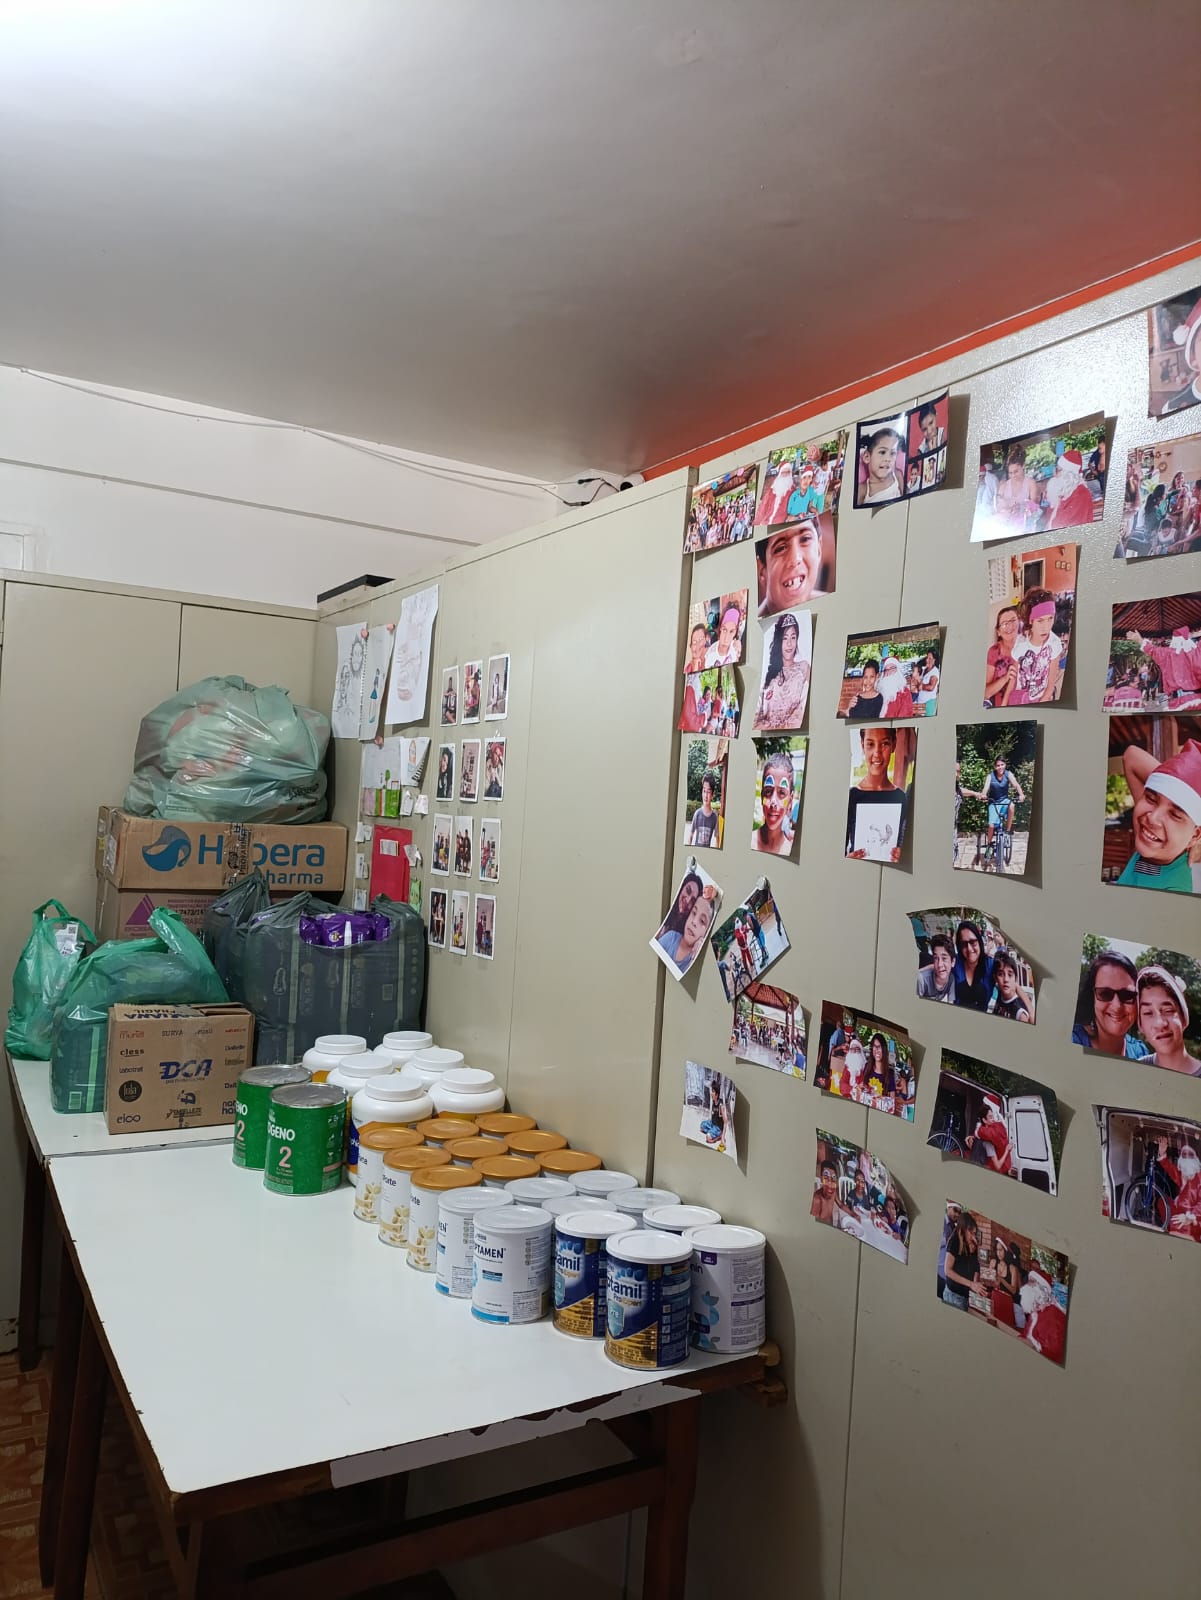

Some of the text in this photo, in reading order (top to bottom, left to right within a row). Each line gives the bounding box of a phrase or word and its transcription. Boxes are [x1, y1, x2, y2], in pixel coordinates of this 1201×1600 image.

[198, 834, 325, 867] Hpera
[262, 869, 324, 885] harma
[120, 1048, 145, 1056] cless
[159, 1059, 214, 1080] DCA
[236, 1119, 246, 1142] 2
[278, 1146, 292, 1169] 2
